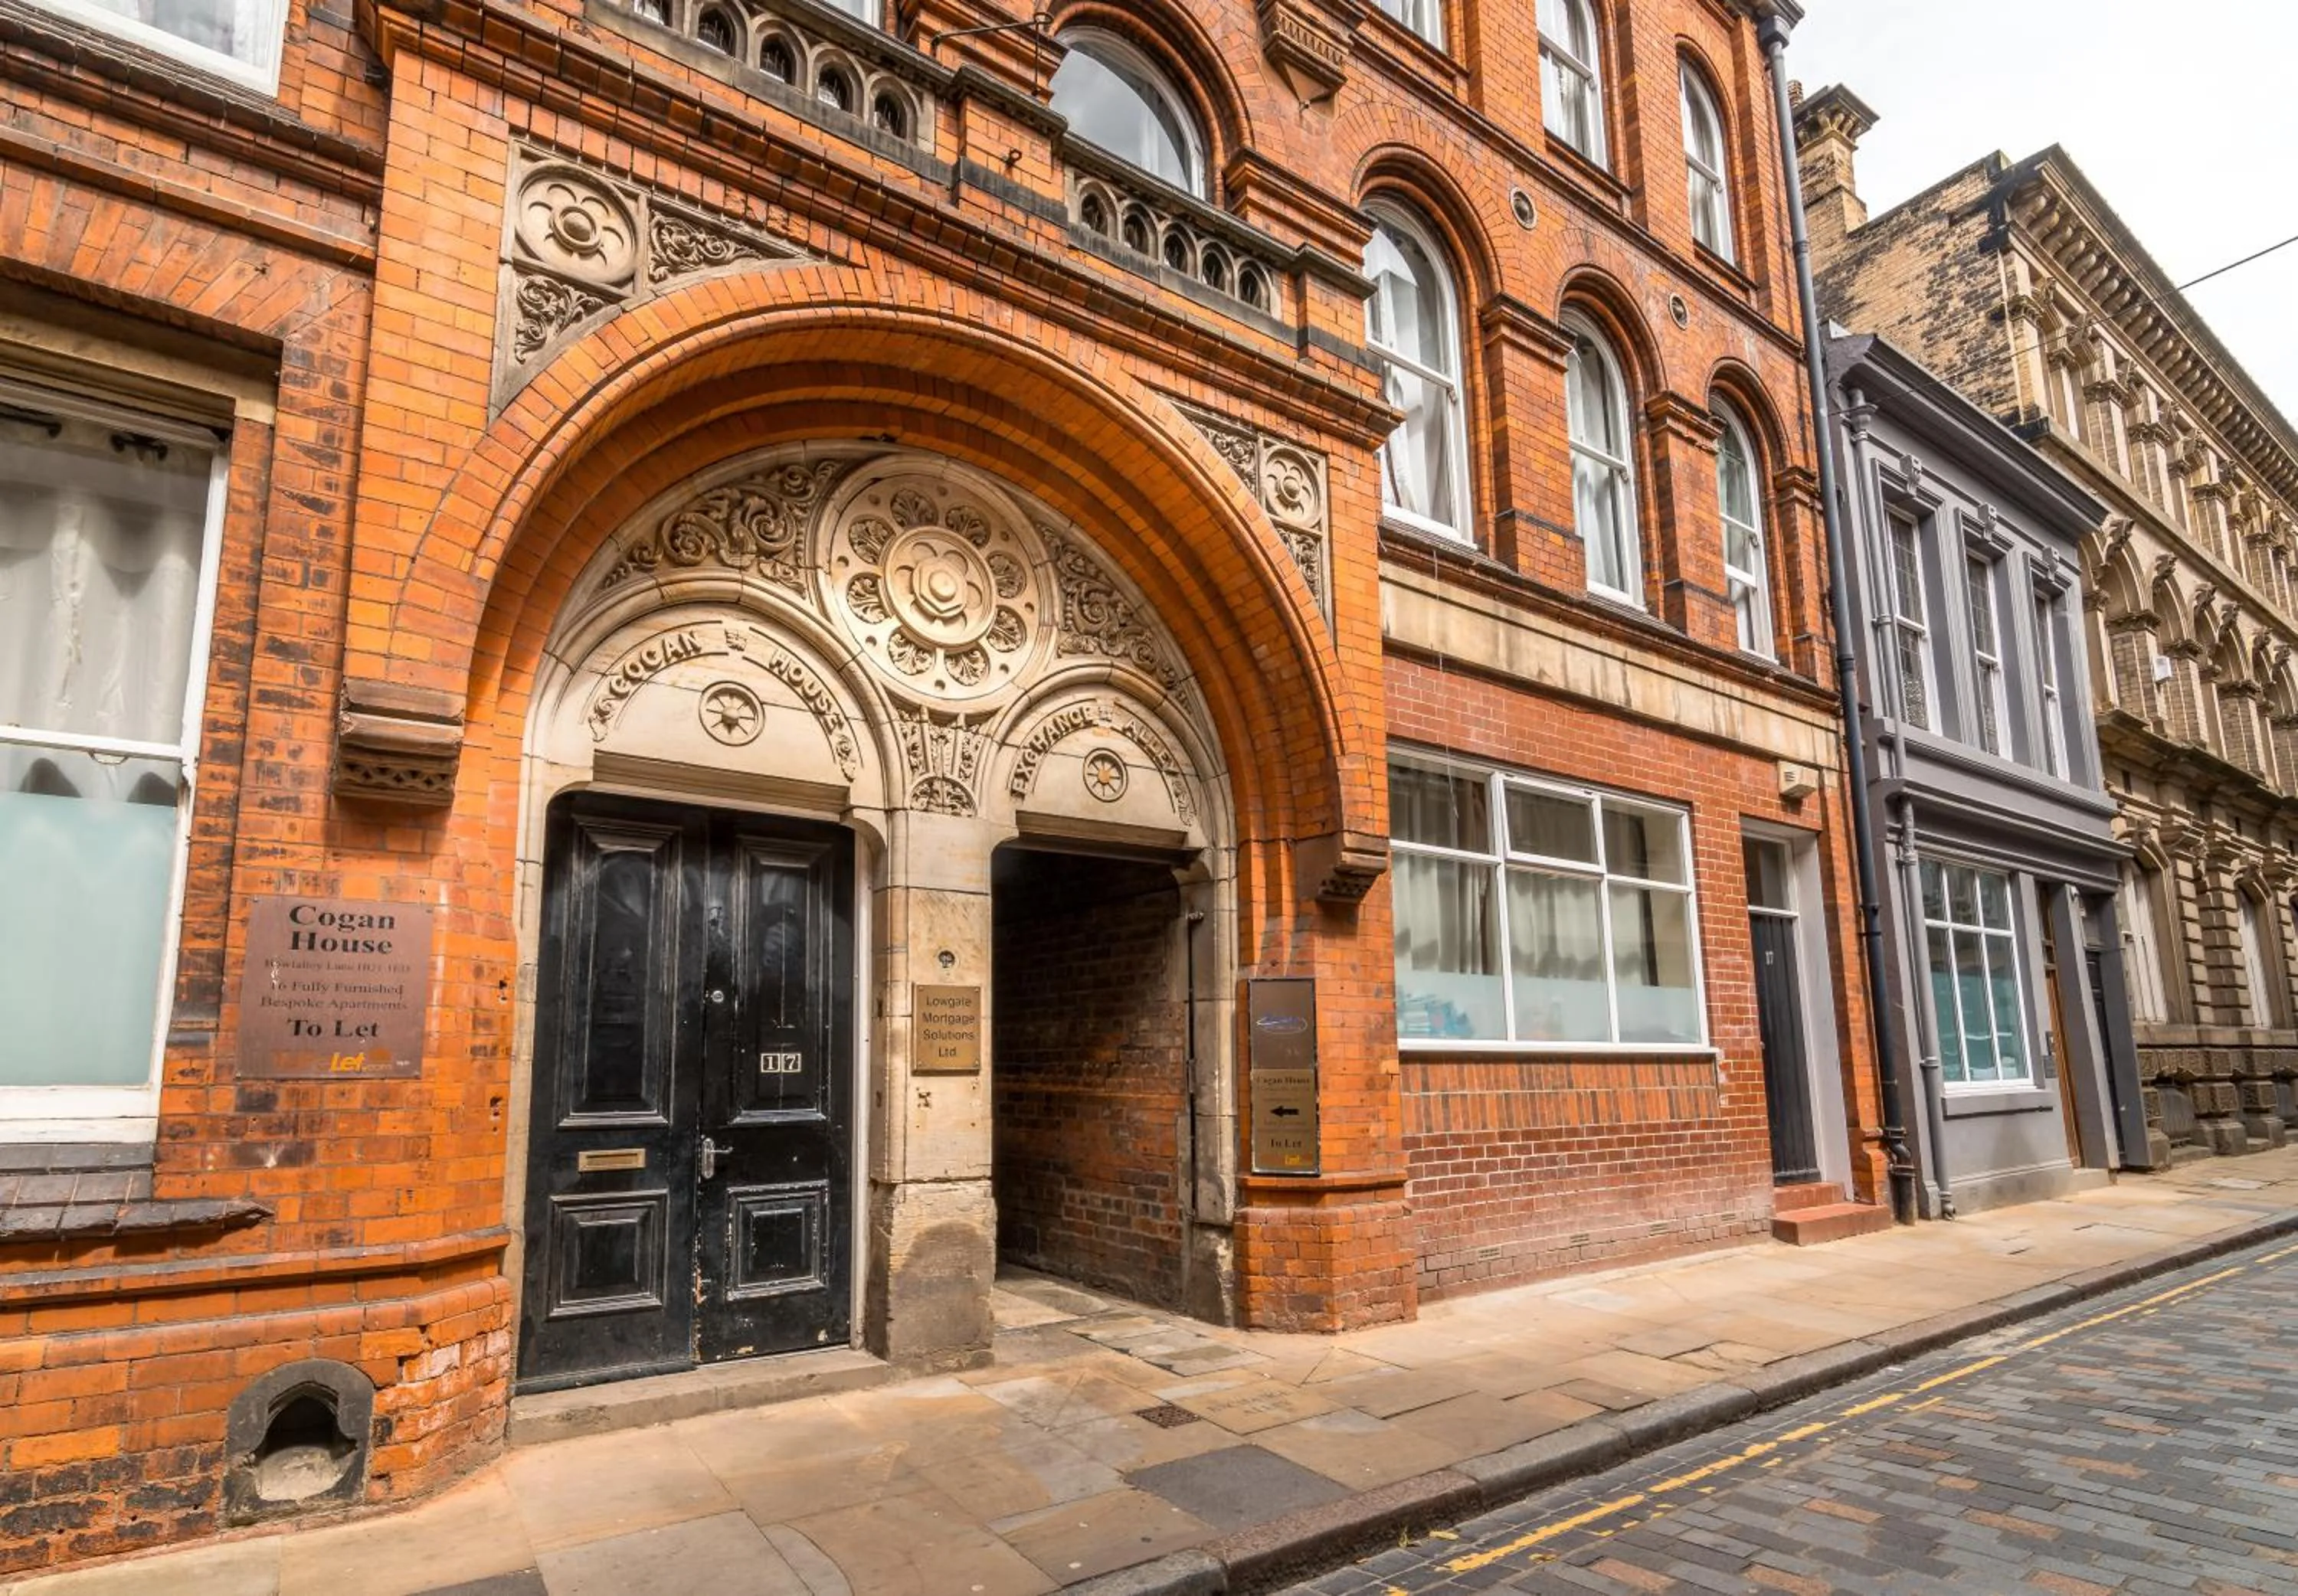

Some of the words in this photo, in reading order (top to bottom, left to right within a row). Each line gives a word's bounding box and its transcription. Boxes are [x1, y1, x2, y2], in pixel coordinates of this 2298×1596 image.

[610, 631, 702, 698] COGAN
[769, 649, 844, 735] HOUSE
[1010, 706, 1098, 800] EXCHANGE
[1122, 720, 1180, 776] ALLEY
[289, 904, 395, 932] Cogan
[290, 930, 393, 954] House
[292, 980, 330, 993] Fully
[335, 982, 404, 996] Furnished
[260, 996, 325, 1010] Bespoke
[330, 998, 408, 1011] Apartments
[926, 996, 972, 1009] Lowgate
[922, 1012, 975, 1025] Mortgage
[287, 1019, 322, 1037] To
[335, 1019, 380, 1038] Let
[923, 1029, 975, 1041] Solutions
[938, 1046, 957, 1058] Ltd
[766, 1055, 795, 1070] 17
